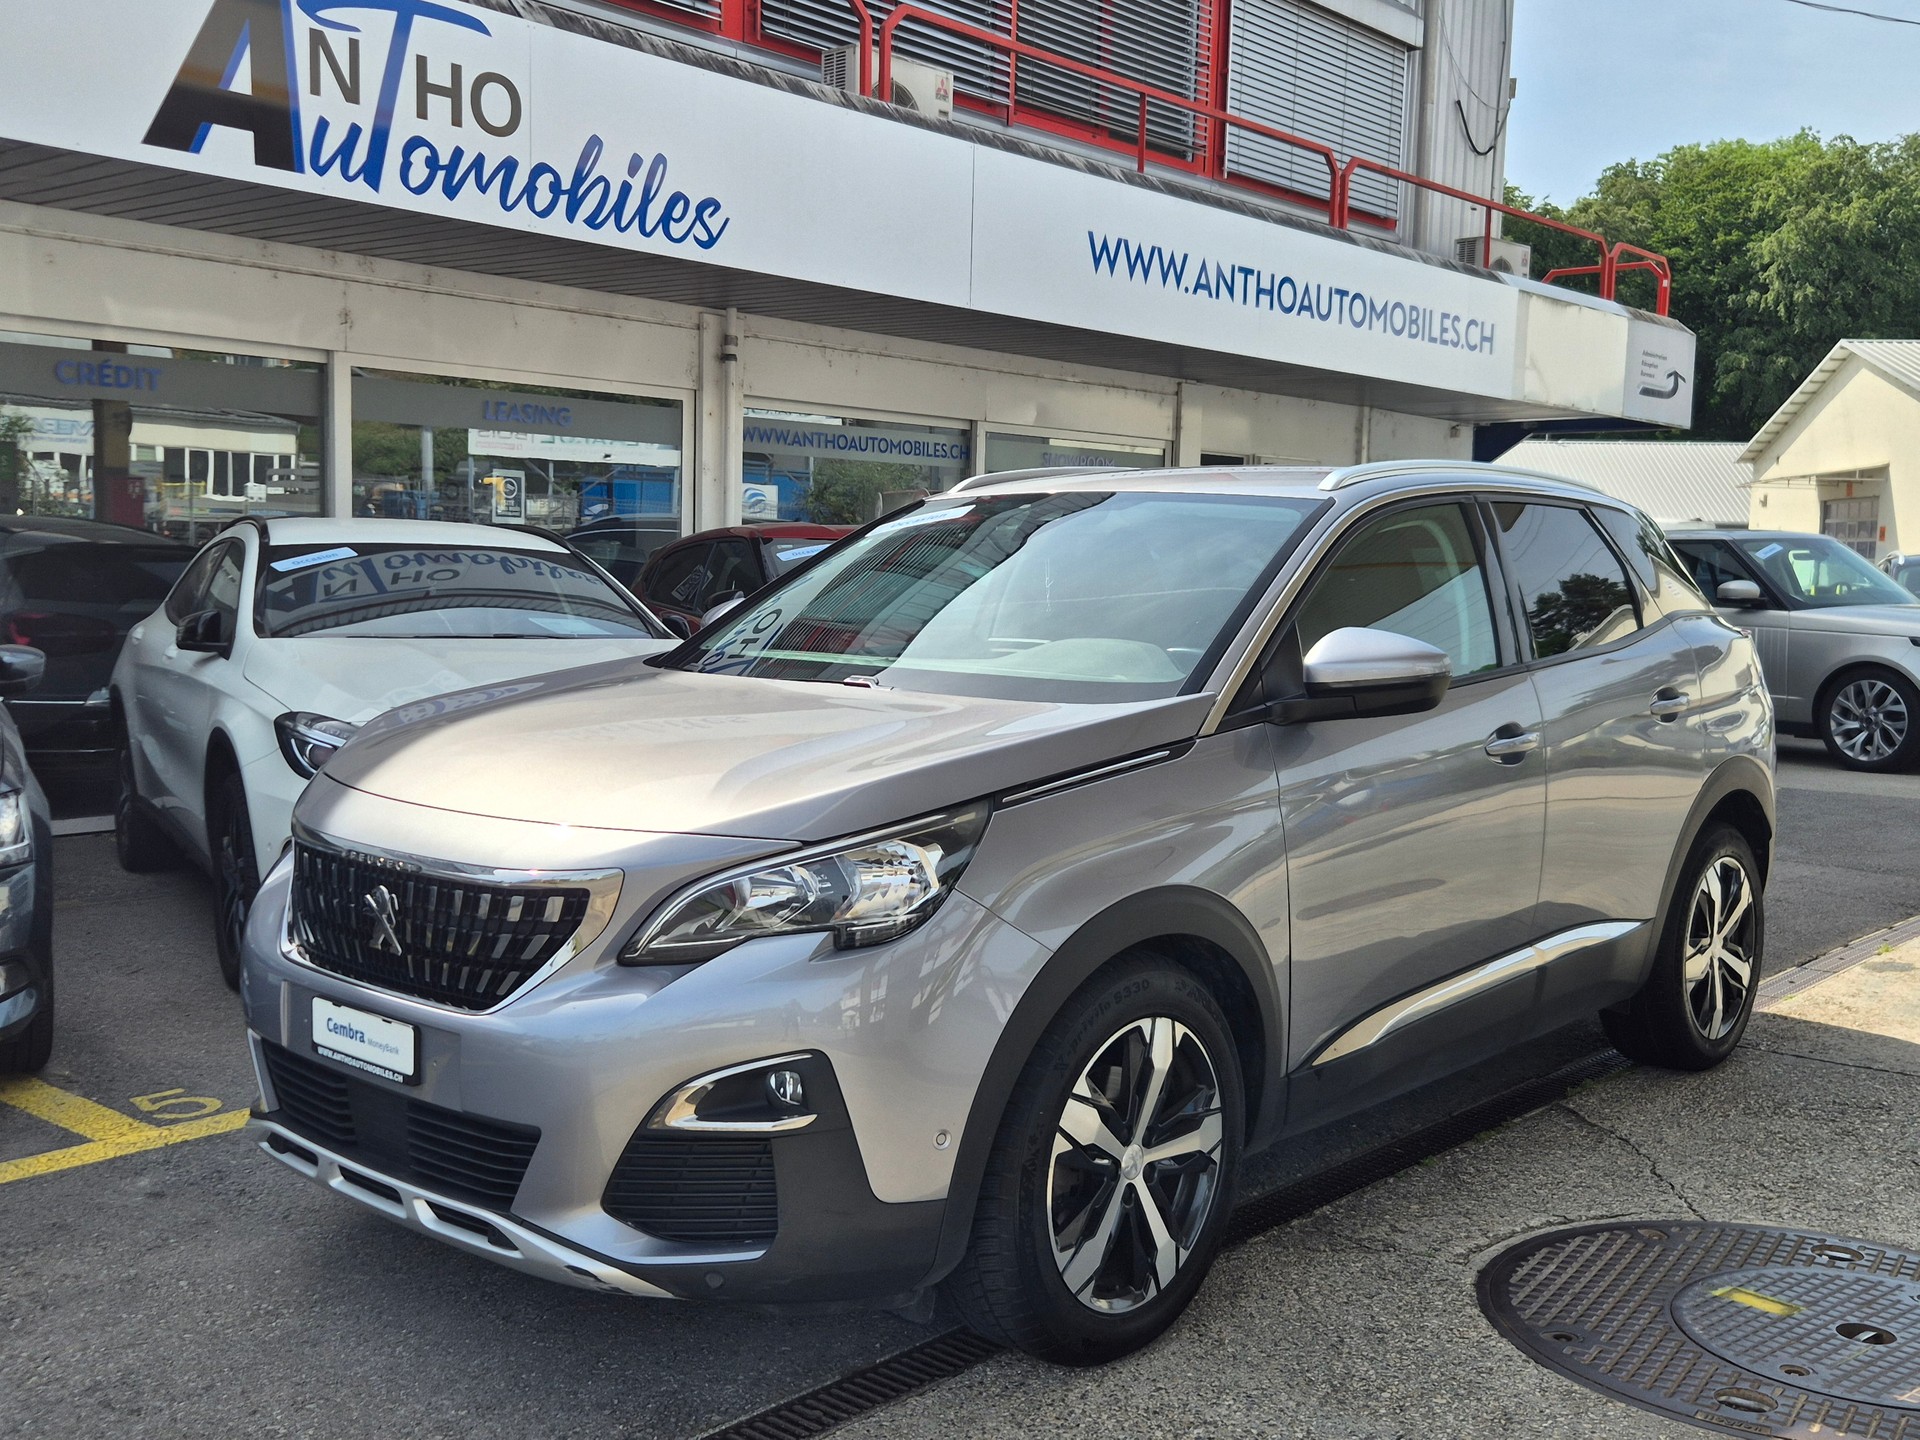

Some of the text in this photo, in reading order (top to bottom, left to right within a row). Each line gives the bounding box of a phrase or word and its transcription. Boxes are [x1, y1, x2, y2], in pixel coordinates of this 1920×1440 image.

[1087, 230, 1496, 355] WWW.ANTHOAUTOMOBILES.CH
[54, 359, 161, 391] CRÉDIT
[483, 400, 573, 427] LEASING
[742, 426, 970, 460] WWW.ANTHOAUTOMOBILES.CH
[327, 1017, 366, 1044] Cembra
[129, 1088, 224, 1119] 5
